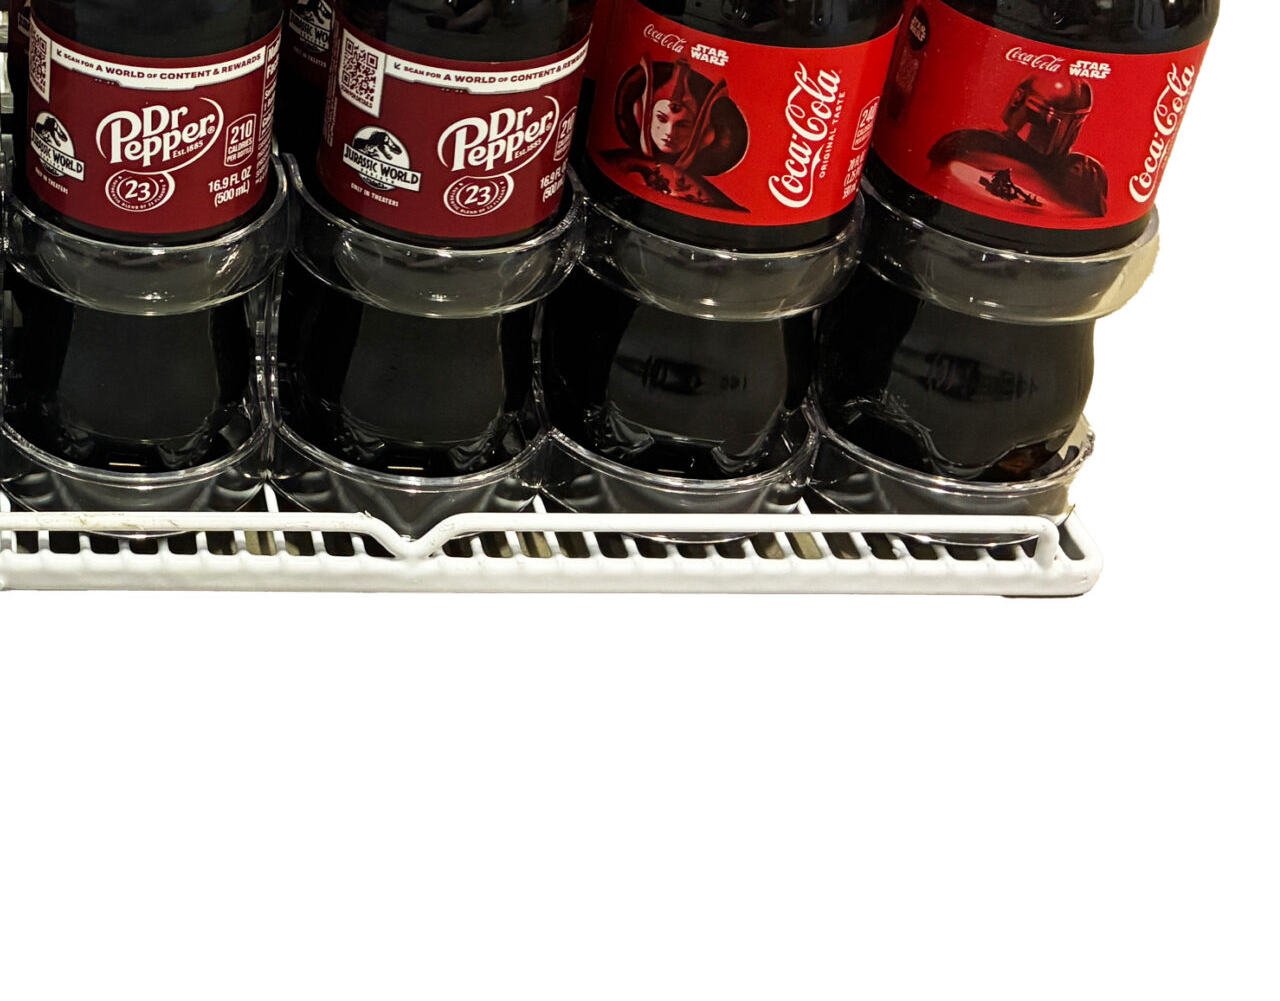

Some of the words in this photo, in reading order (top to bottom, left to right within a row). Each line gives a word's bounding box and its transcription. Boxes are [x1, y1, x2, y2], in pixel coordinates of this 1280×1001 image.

[691, 43, 729, 58] STAR
[691, 50, 729, 67] WARS
[63, 53, 80, 65] SCAN
[81, 60, 94, 69] FOR
[96, 64, 103, 72] A
[106, 67, 145, 79] WORLD
[159, 69, 211, 80] CONTENT
[212, 68, 220, 76] &
[221, 54, 262, 74] REWARDS
[403, 65, 425, 76] SCAN
[454, 75, 496, 84] WORLD
[510, 68, 556, 82] CONTENT
[1070, 68, 1111, 79] WARS
[1075, 60, 1111, 72] STAR
[141, 105, 189, 138] Dr
[230, 119, 253, 145] 210
[488, 106, 533, 143] Dr
[768, 61, 841, 208] Coca-Cola
[819, 128, 837, 179] ORIGINAL
[832, 91, 846, 125] TASTE
[1129, 62, 1194, 203] Coca-Cola
[96, 110, 216, 167] Pepper
[437, 111, 554, 172] Pepper
[53, 149, 83, 174] WORLD
[344, 146, 378, 173] JURASSIC
[380, 163, 419, 185] WORLD
[125, 179, 151, 201] 23
[208, 177, 229, 193] 16.9
[230, 173, 240, 186] FL
[241, 166, 252, 180] OZ
[214, 189, 235, 207] (500
[235, 180, 251, 197] mL)
[372, 192, 399, 207] THEATERS
[464, 184, 491, 206] 23
